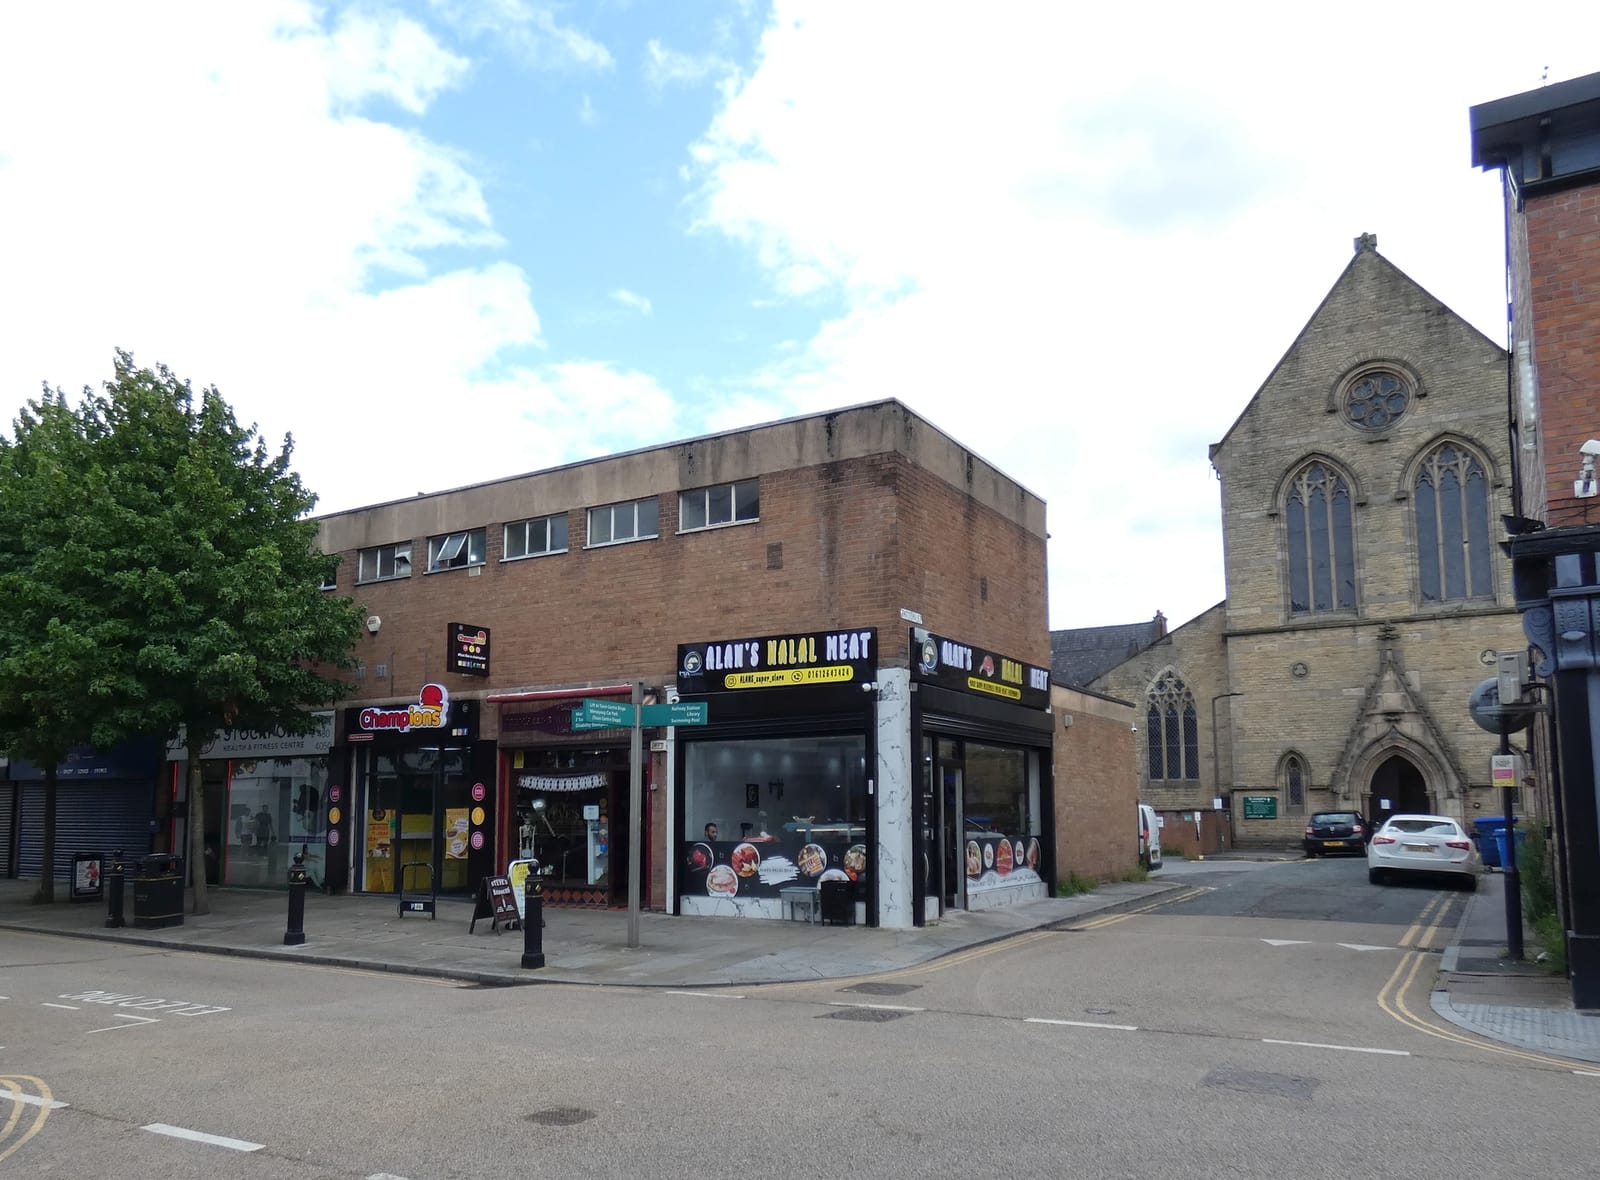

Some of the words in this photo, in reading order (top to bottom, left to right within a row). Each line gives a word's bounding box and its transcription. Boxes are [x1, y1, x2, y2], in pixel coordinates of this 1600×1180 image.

[705, 642, 760, 671] ALAN'S
[767, 637, 817, 666] HALAL
[826, 632, 872, 662] MEAT
[942, 640, 972, 671] ALAN'S
[1001, 658, 1023, 685] HALAL
[1030, 667, 1049, 692] MEAT
[360, 706, 441, 732] Champions
[223, 744, 247, 752] HEALTH
[253, 742, 279, 751] FITNESS
[280, 741, 305, 749] CENTRE
